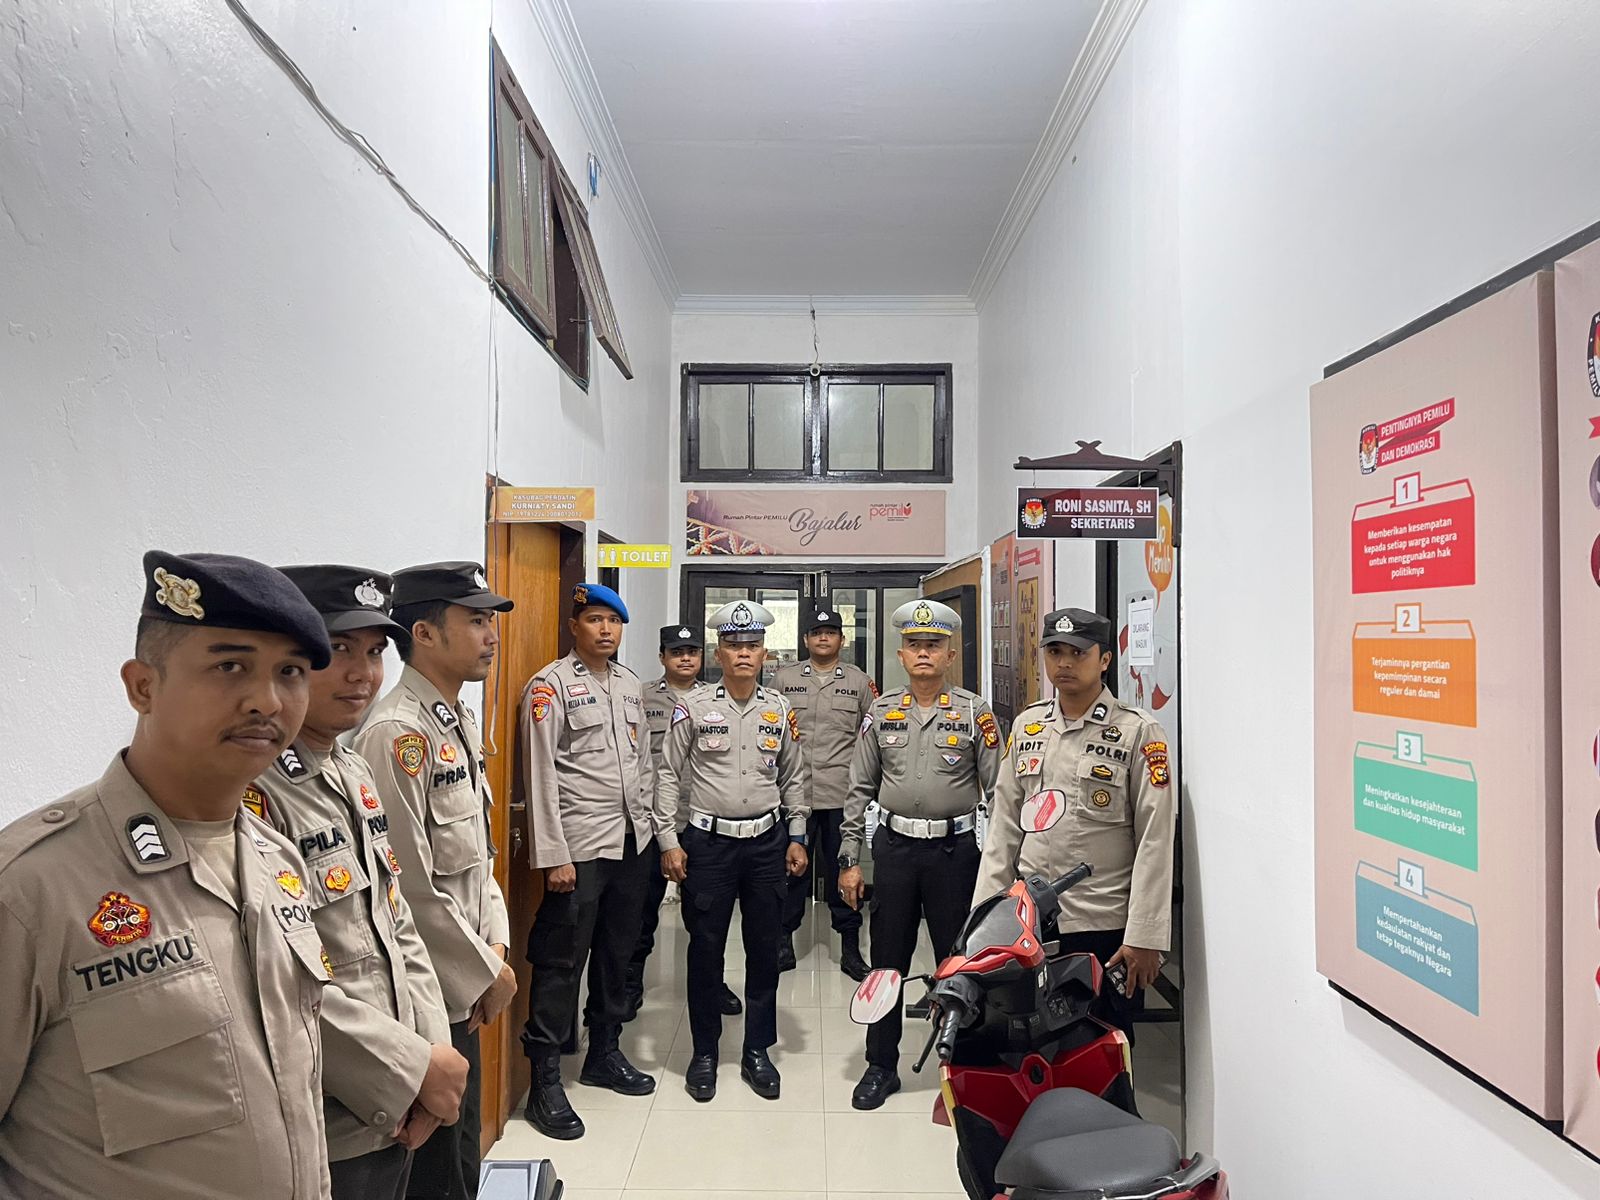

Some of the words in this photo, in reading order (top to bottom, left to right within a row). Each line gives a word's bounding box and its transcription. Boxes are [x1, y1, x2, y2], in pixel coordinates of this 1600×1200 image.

[1381, 412, 1422, 437] PENTINGNYA
[1423, 402, 1450, 423] PEMILU
[1381, 451, 1395, 463] DAN
[1396, 436, 1435, 458] DEMOKRASI
[1402, 481, 1408, 499] 1
[551, 502, 575, 510] SANDI
[1055, 499, 1082, 513] RONI
[1085, 499, 1134, 516] SASNITA,
[1136, 500, 1152, 513] SH
[788, 507, 863, 547] Bajalur
[1070, 518, 1136, 530] SEKRETARIS
[1367, 525, 1408, 540] Memberikan
[1408, 518, 1453, 534] kesempatan
[1363, 544, 1386, 556] kepada
[1386, 540, 1407, 552] setiap
[1408, 537, 1430, 549] warga
[1431, 532, 1457, 545] negara
[621, 551, 668, 562] TOILET
[1368, 557, 1388, 567] untuk
[1388, 550, 1436, 565] menggunakan
[1437, 547, 1451, 558] hak
[1391, 566, 1425, 580] politiknya
[1402, 609, 1411, 628] 2
[1371, 656, 1411, 670] Terjaminnya
[1411, 658, 1451, 672] pergantian
[1374, 670, 1422, 684] kepemimpinan
[1423, 675, 1447, 685] secara
[835, 688, 858, 696] POLRI
[1379, 685, 1403, 697] reguler
[1404, 686, 1417, 697] dan
[1418, 687, 1441, 699] damai
[646, 710, 665, 719] DANI
[758, 725, 783, 736] POLRI
[880, 722, 909, 731] MUSLIM
[937, 722, 969, 733] POLRI
[1019, 741, 1044, 752] ADIT
[1085, 744, 1128, 762] POLRI
[1404, 738, 1412, 756] 3
[433, 765, 467, 788] PRAS
[1364, 783, 1410, 805] Meningkatkan
[1410, 795, 1463, 819] kesejahteraan
[1362, 797, 1375, 808] dan
[1375, 799, 1401, 816] kualitas
[1401, 807, 1421, 824] hidup
[1422, 814, 1466, 836] masyarakat
[299, 826, 347, 858] PILA
[1405, 868, 1414, 887] 4
[1383, 905, 1443, 942] Mempertahankan
[1376, 915, 1413, 942] kedaulatan
[1413, 935, 1437, 954] rakyat
[1436, 946, 1452, 961] dan
[1376, 930, 1393, 947] tetap
[1393, 939, 1425, 963] tegaknya
[1425, 954, 1452, 977] Negara
[75, 935, 194, 992] TENGKU
